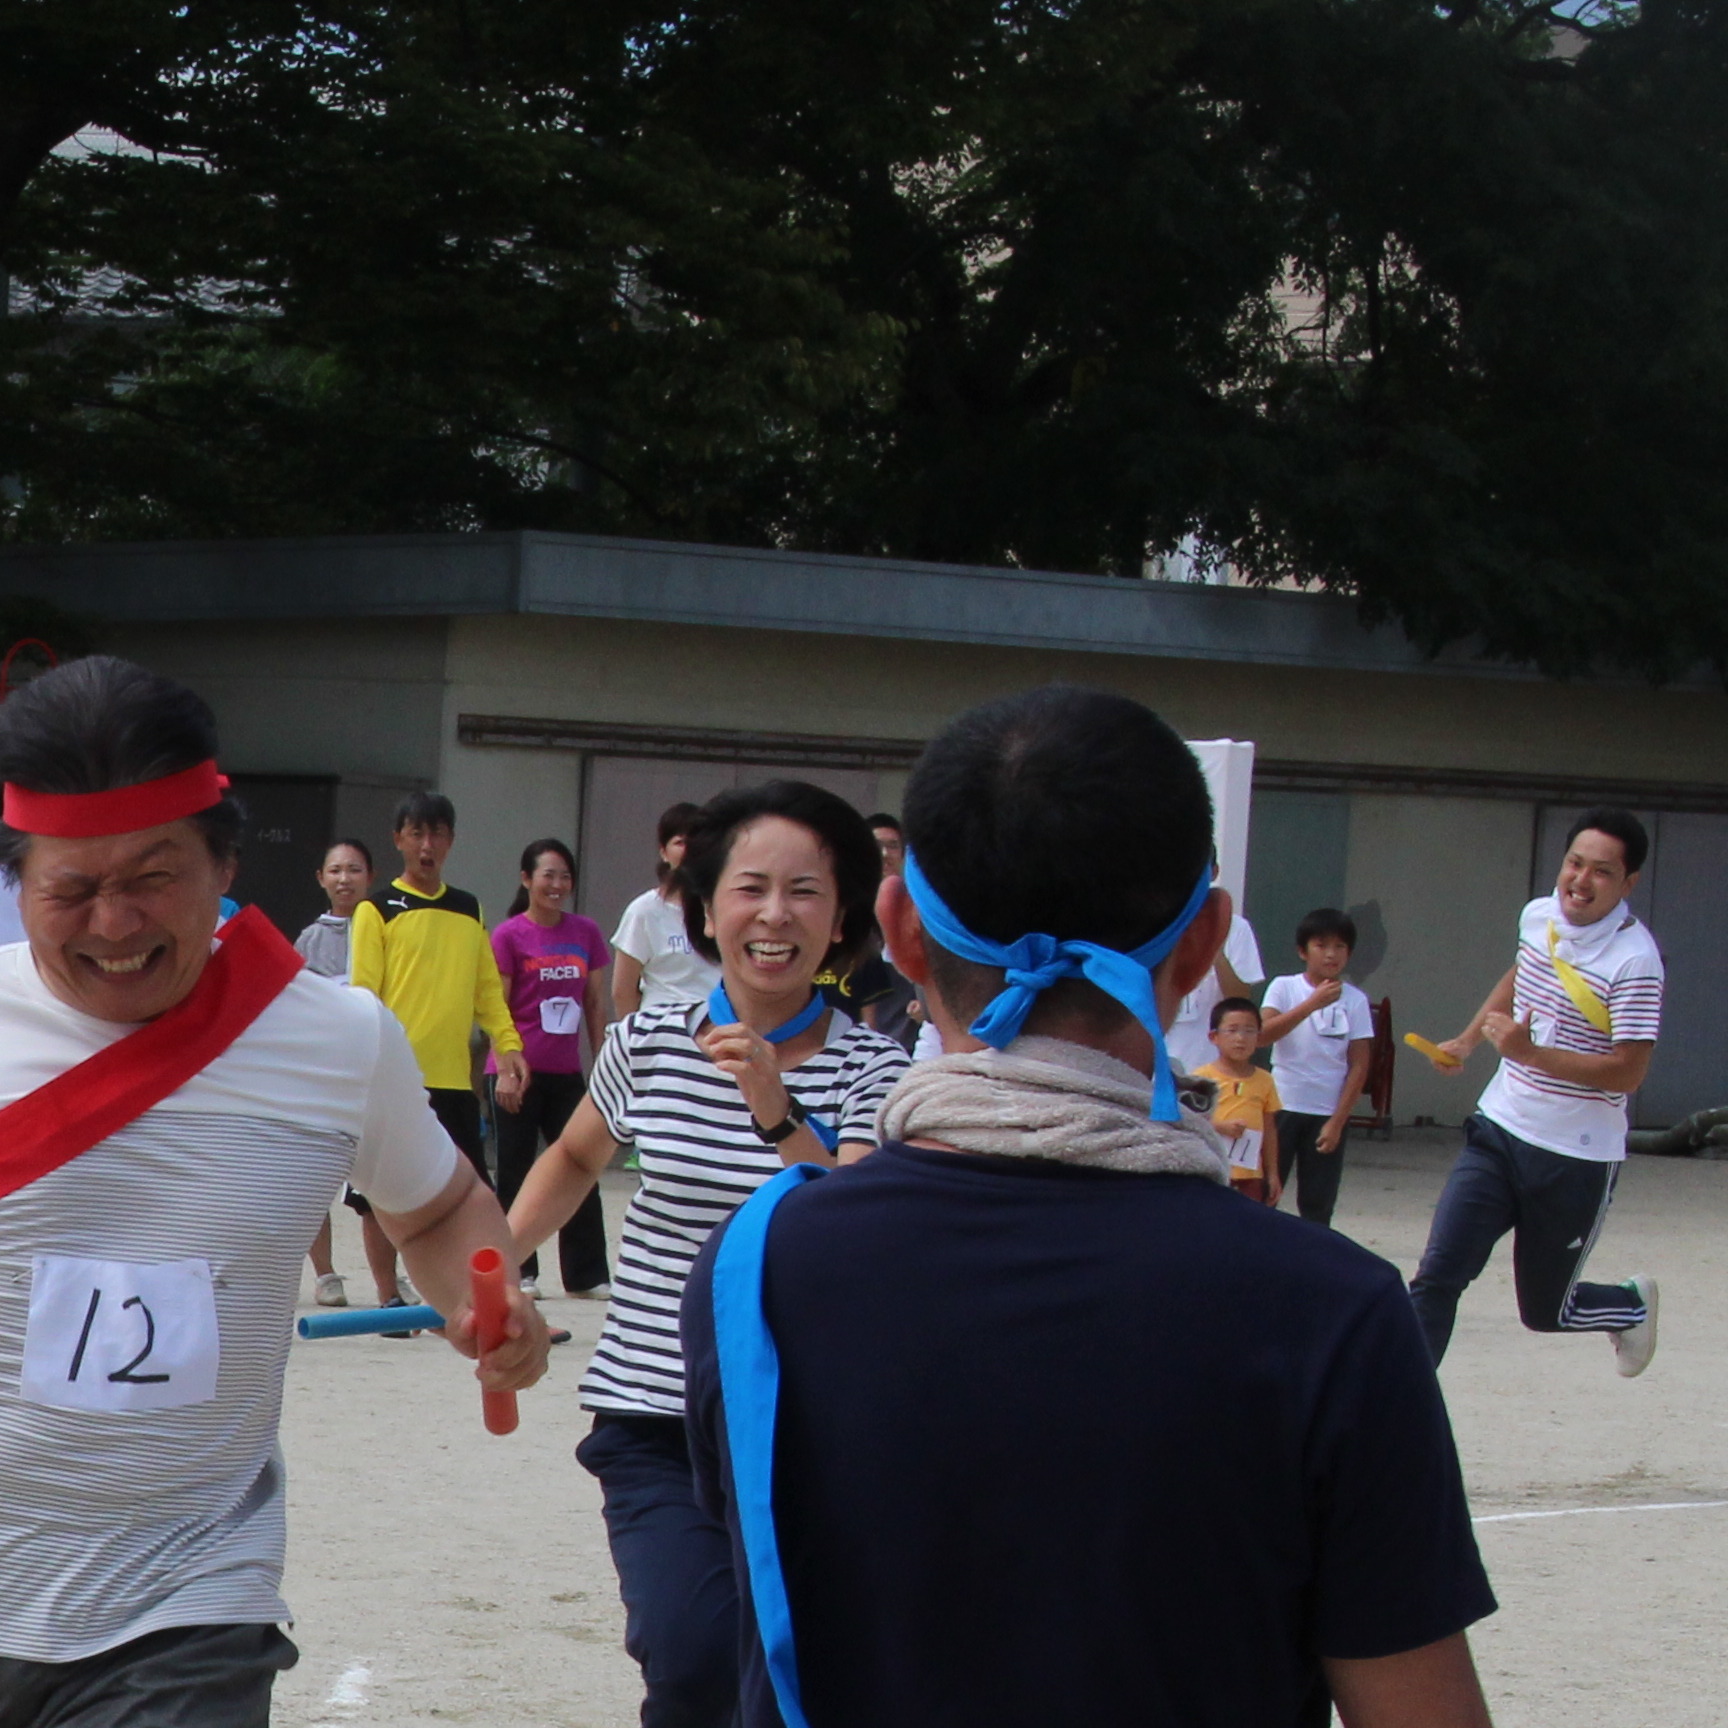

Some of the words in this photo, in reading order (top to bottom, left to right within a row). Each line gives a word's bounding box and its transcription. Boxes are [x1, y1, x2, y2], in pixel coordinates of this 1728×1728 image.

[539, 966, 574, 982] FACE
[552, 1001, 570, 1028] 7
[1227, 1137, 1251, 1173] 11
[67, 1288, 171, 1382] 12
